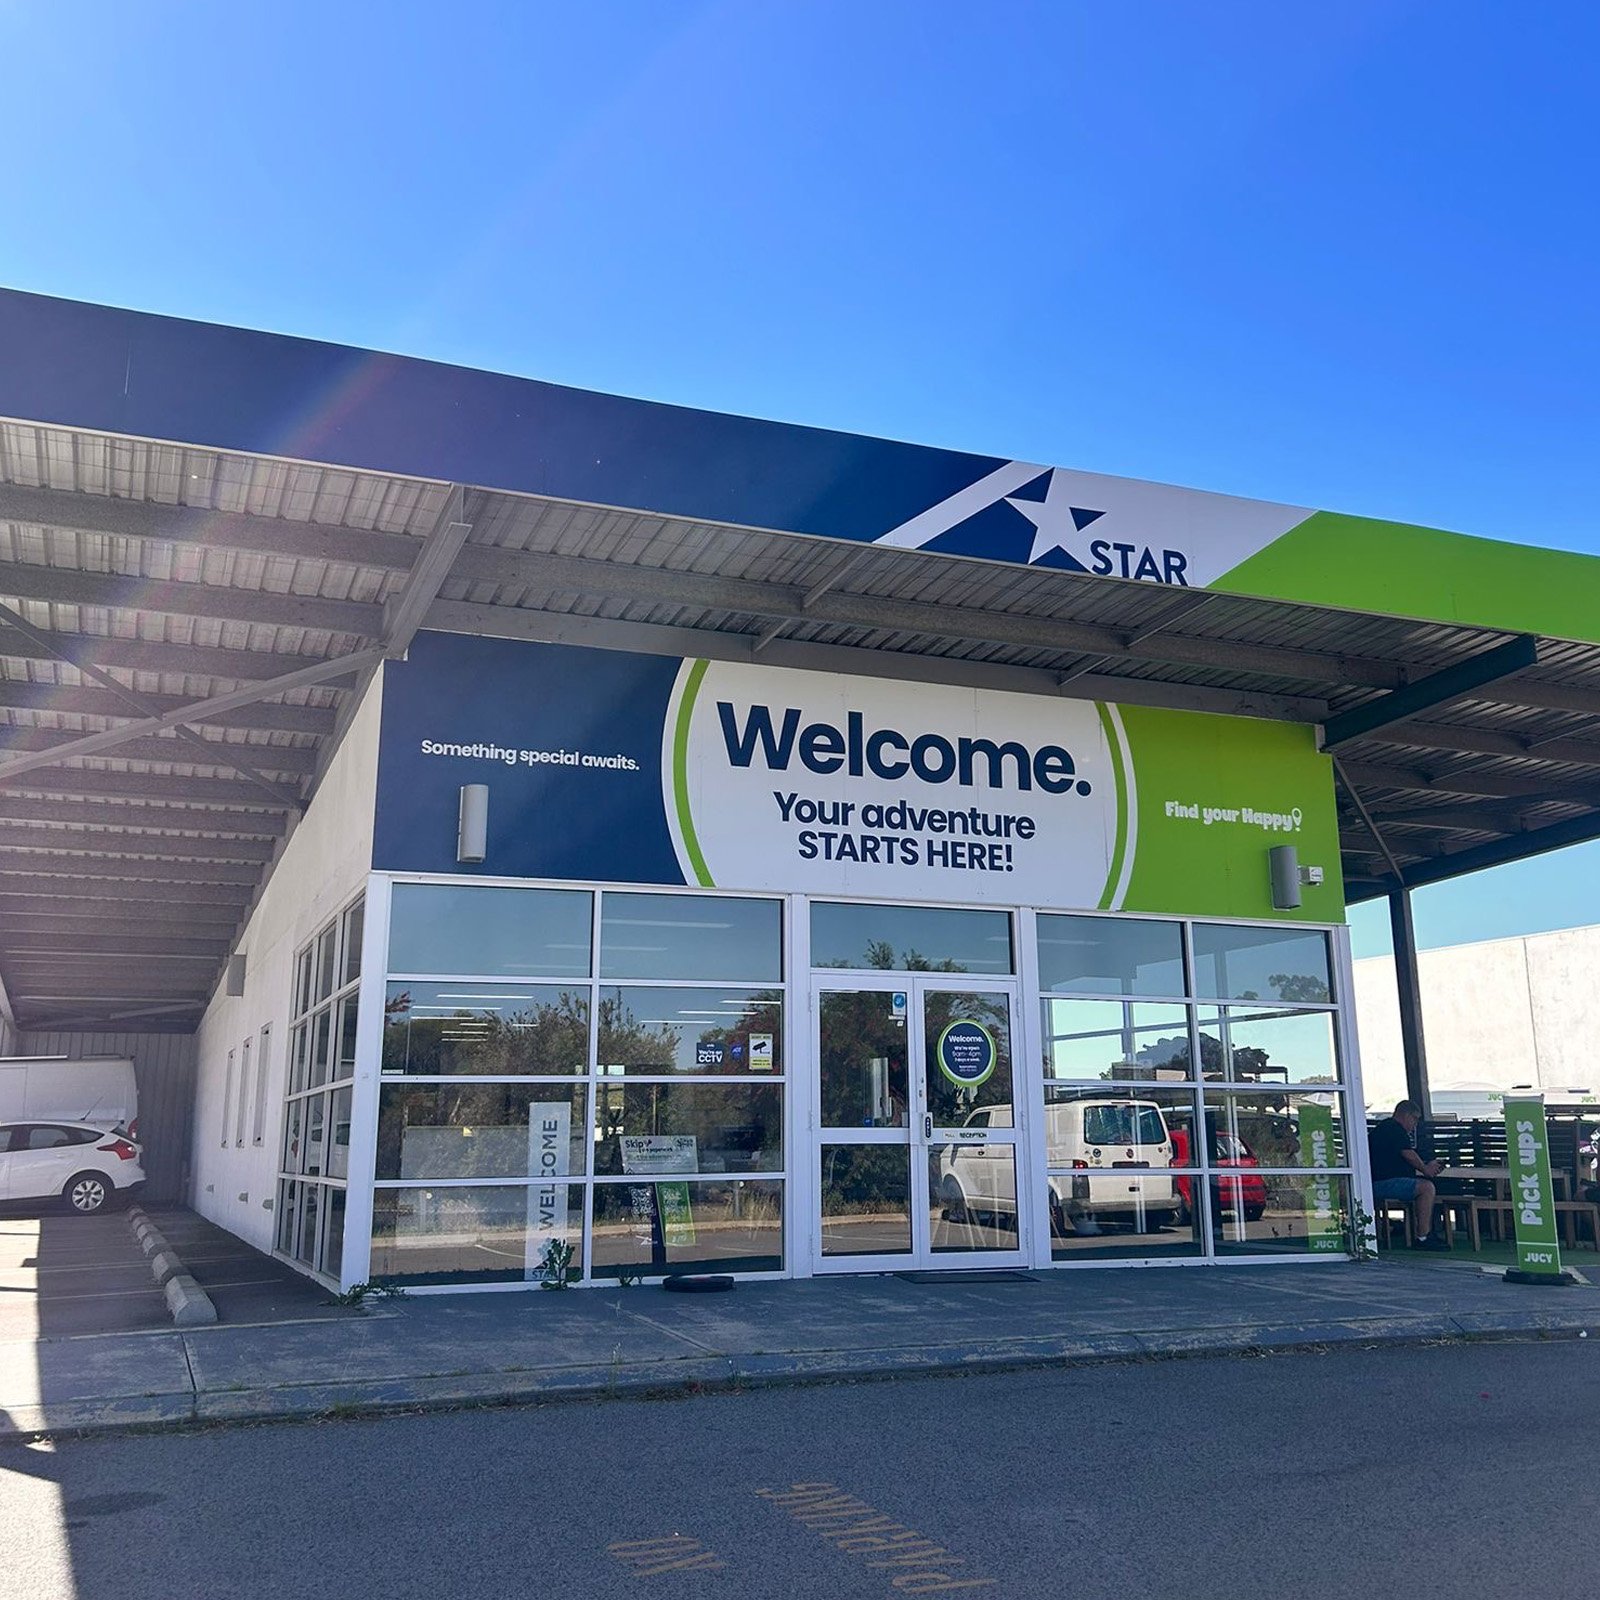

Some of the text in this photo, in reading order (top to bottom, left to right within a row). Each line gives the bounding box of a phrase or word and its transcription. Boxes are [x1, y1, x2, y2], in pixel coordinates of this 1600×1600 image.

[1090, 539, 1189, 587] STAR
[421, 739, 640, 771] Something special awaits.
[716, 700, 1092, 797] Welcome.
[773, 791, 1036, 840] Your adventure
[1164, 800, 1200, 819] Find
[1202, 807, 1240, 825] your
[798, 831, 1014, 872] STARTS HERE!
[698, 1055, 723, 1063] CCTV
[539, 1119, 557, 1231] WELCOME
[1517, 1119, 1543, 1226] Pick ups
[1313, 1240, 1338, 1250] JUCY
[1524, 1252, 1553, 1264] JUCY
